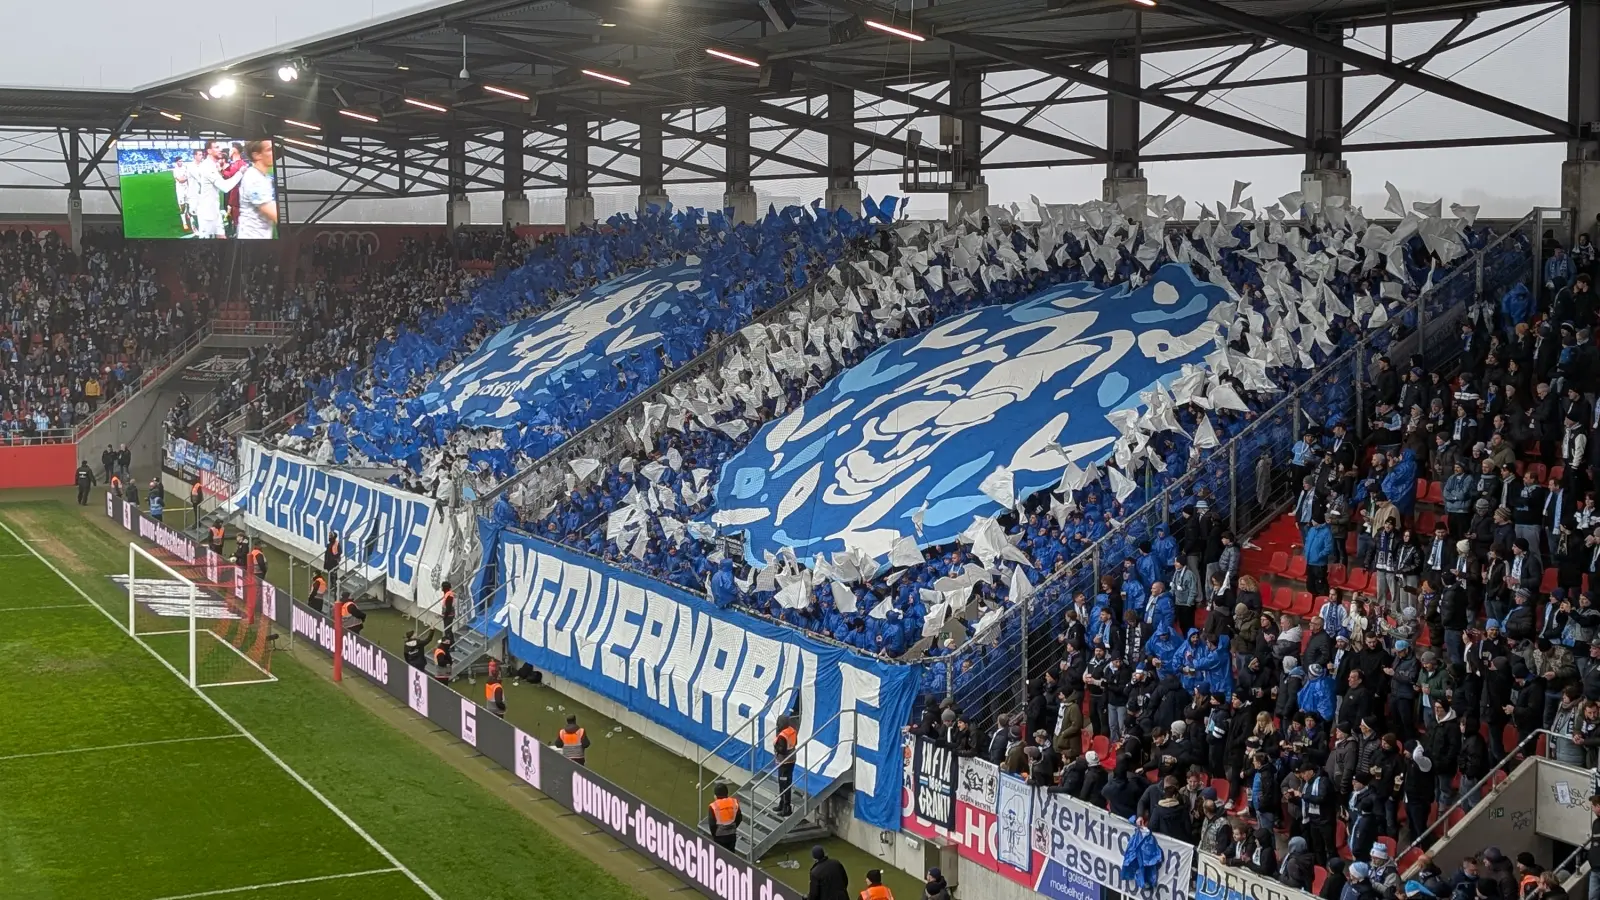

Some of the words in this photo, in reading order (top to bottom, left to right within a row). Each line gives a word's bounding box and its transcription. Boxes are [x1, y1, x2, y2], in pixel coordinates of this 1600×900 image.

[266, 456, 431, 586] GENERAZIONE
[293, 604, 389, 685] unvor-deuchland.de
[572, 770, 785, 900] gunvor-deutschlandd
[1035, 785, 1181, 877] Vierkircn
